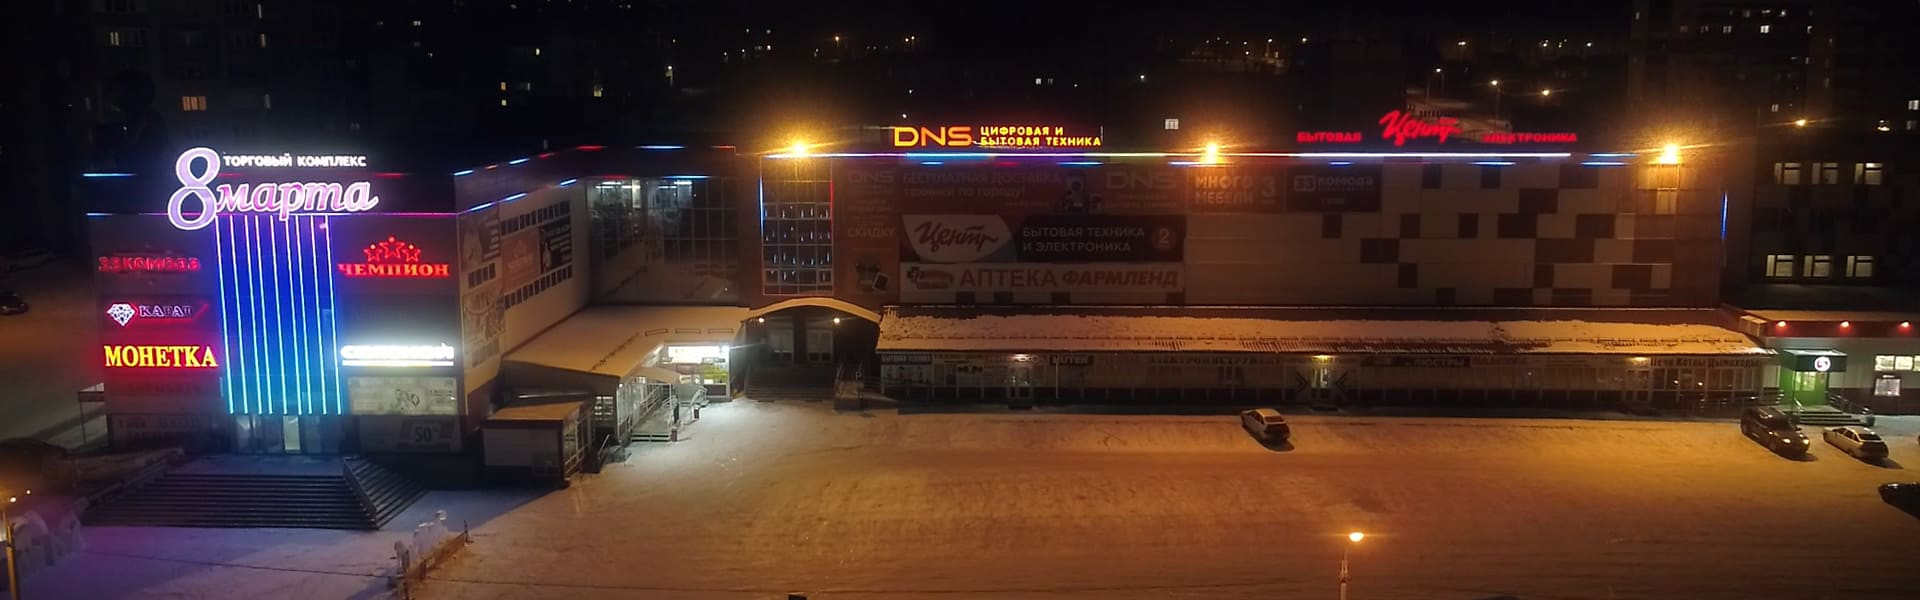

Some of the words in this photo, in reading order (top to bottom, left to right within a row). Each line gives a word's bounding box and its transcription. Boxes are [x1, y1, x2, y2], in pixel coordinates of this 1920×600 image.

[980, 126, 1049, 137] ЦИФРОВАЯ
[1055, 127, 1064, 136] И
[1379, 110, 1462, 145] Центр
[894, 126, 972, 147] DNS
[980, 137, 1041, 147] БЫТОВАЯ
[1046, 137, 1101, 147] ТЕХНИКА
[1297, 131, 1362, 143] БЫТОВАЯ
[222, 153, 292, 168] ТОРГОВЫЙ
[297, 155, 367, 168] КОМПЛЕКС
[168, 148, 220, 230] 8
[1106, 171, 1176, 190] DNS
[214, 180, 379, 220] марта
[914, 221, 998, 252] Центр
[1023, 226, 1084, 239] БЫТОВАЯ
[1088, 226, 1145, 239] ТЕХНИКА
[1159, 228, 1169, 244] 2
[1023, 243, 1033, 254] И
[1037, 242, 1132, 254] ЭЛЕКТРОНИКА
[338, 263, 449, 278] ЧЕМПИОН
[960, 269, 1057, 289] АПТЕКА
[1062, 270, 1178, 289] ФАРМЛЕНД
[104, 345, 217, 368] МОНЕТКА
